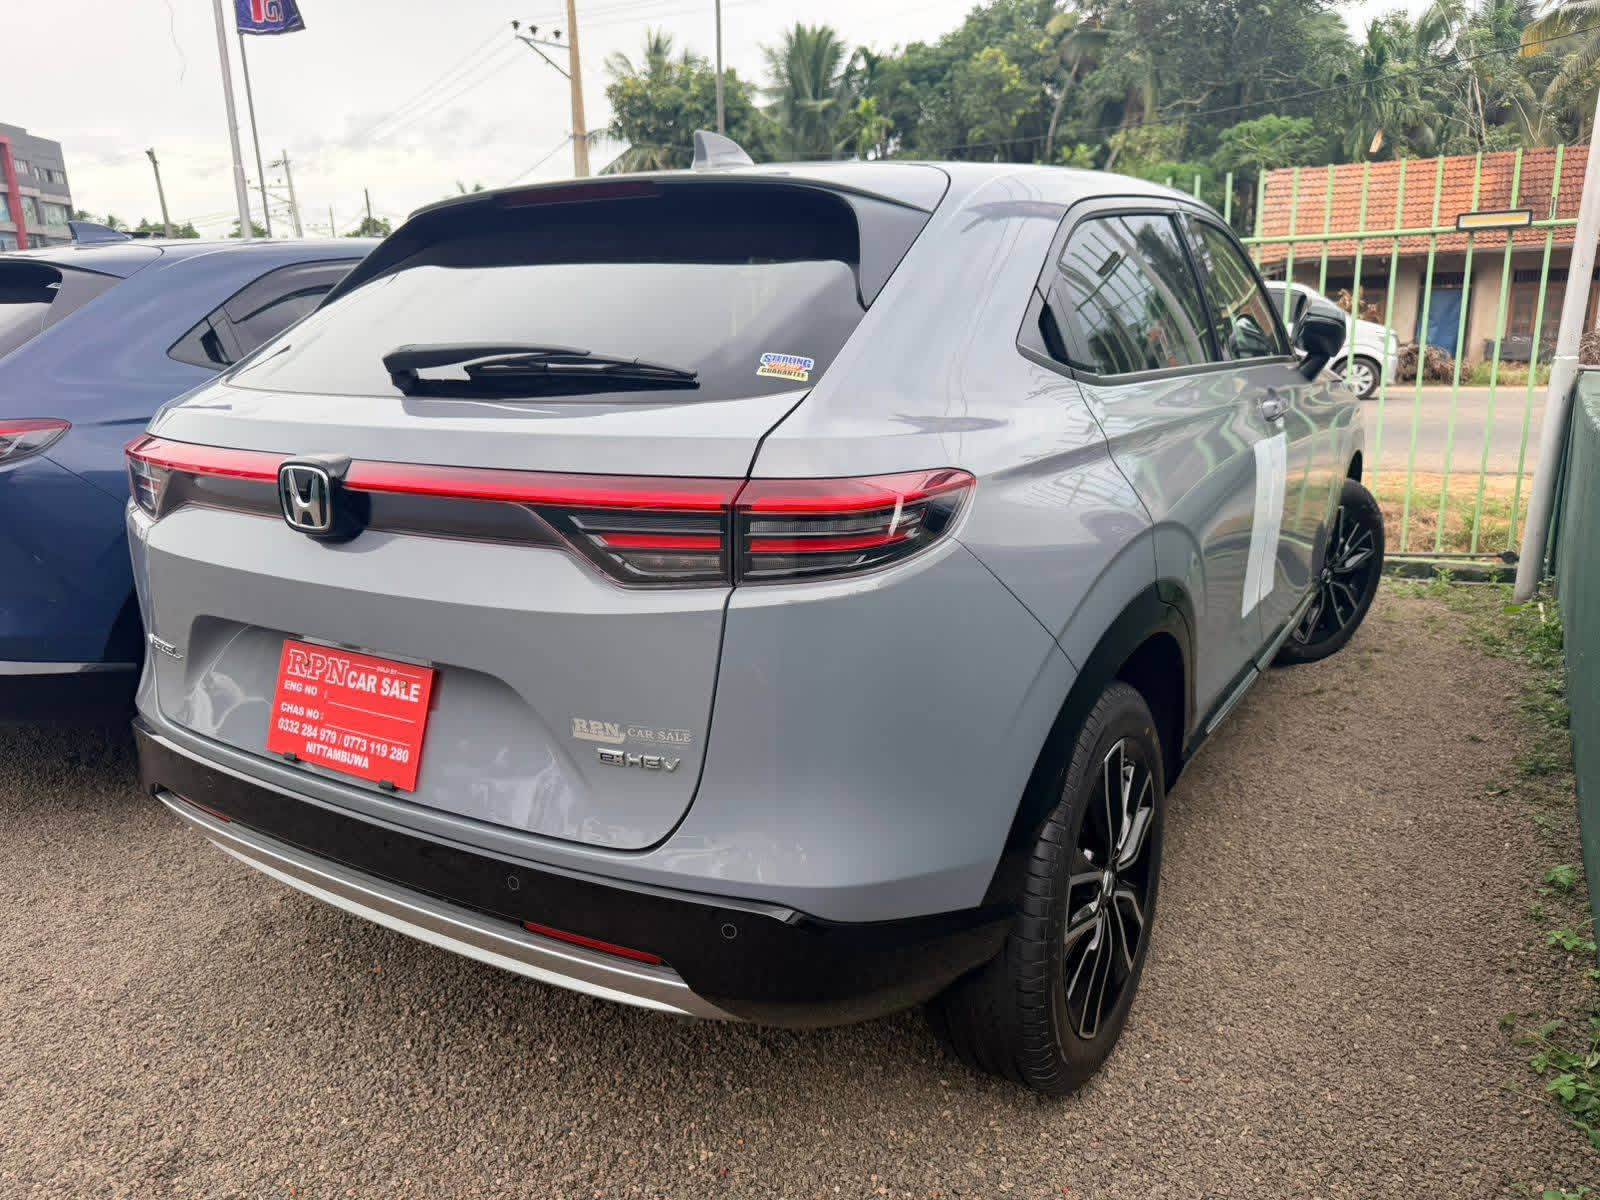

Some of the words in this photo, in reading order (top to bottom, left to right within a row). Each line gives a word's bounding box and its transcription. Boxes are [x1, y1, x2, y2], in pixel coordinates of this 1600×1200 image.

[763, 354, 812, 369] STERLING
[283, 680, 303, 692] ENG
[287, 648, 350, 686] RPN
[347, 671, 377, 694] CAR
[380, 678, 421, 702] SALE
[280, 702, 305, 717] CHAS
[277, 717, 300, 734] 0332
[301, 723, 318, 739] 284
[319, 727, 337, 744] 979
[343, 734, 367, 752] 0773
[369, 742, 388, 757] 119
[389, 746, 409, 763] 280
[572, 717, 625, 744] RPN
[626, 727, 655, 740] CAR
[657, 730, 692, 743] SALE
[305, 742, 370, 769] NITTAMBUWA
